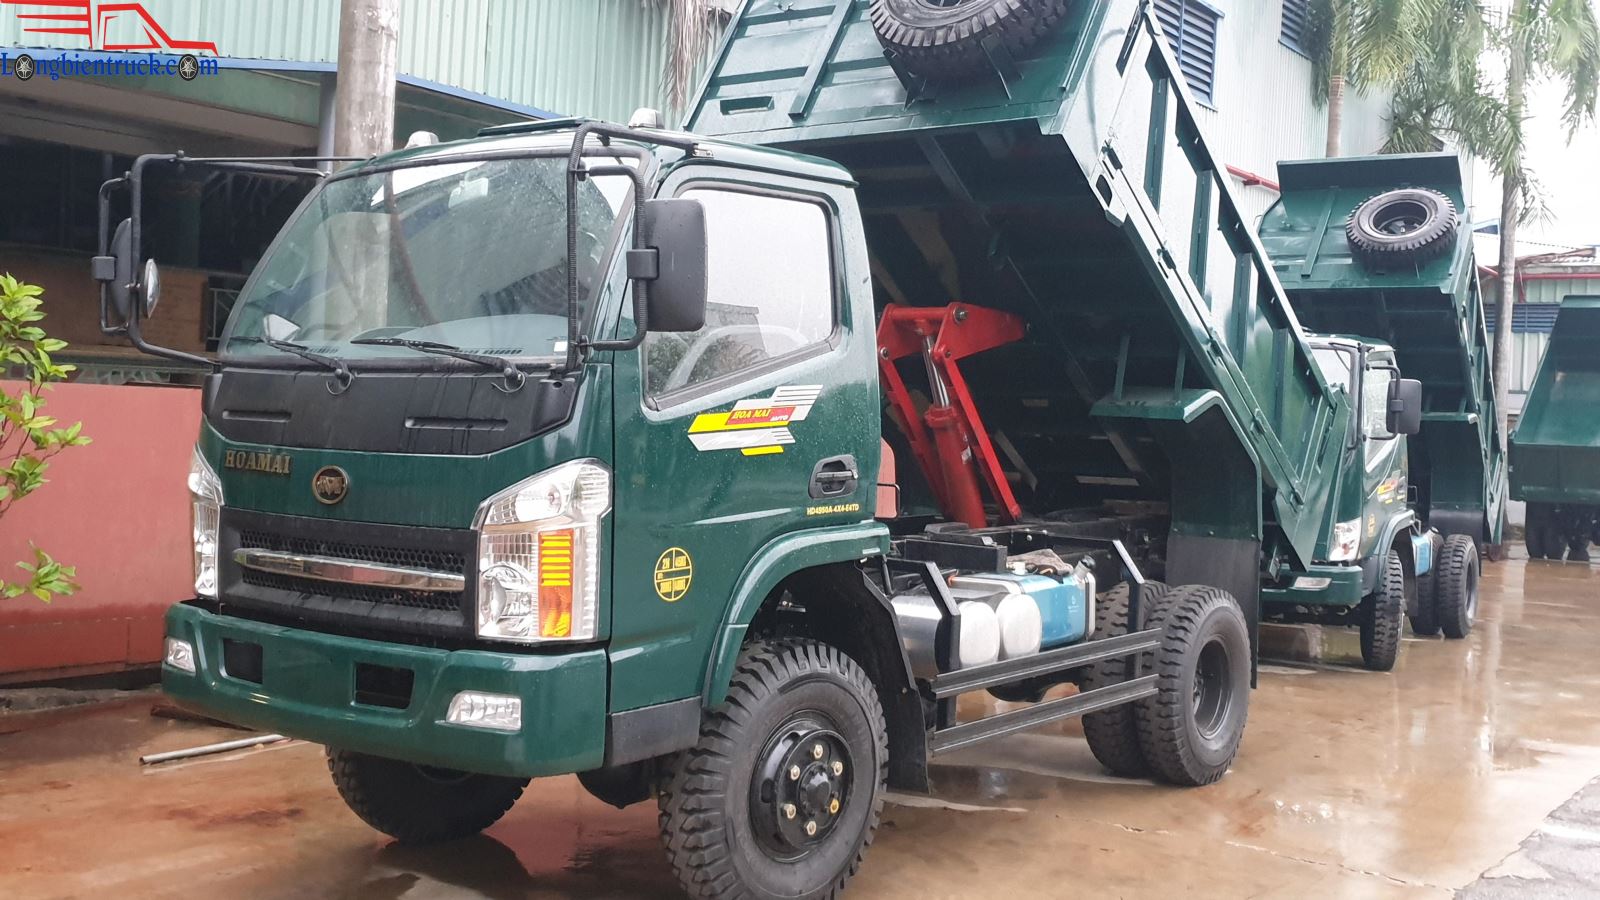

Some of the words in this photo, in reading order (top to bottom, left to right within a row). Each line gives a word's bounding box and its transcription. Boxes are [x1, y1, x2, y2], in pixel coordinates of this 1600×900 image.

[732, 410, 752, 419] HOA
[752, 408, 770, 418] MAI
[225, 448, 291, 474] HOAMAI
